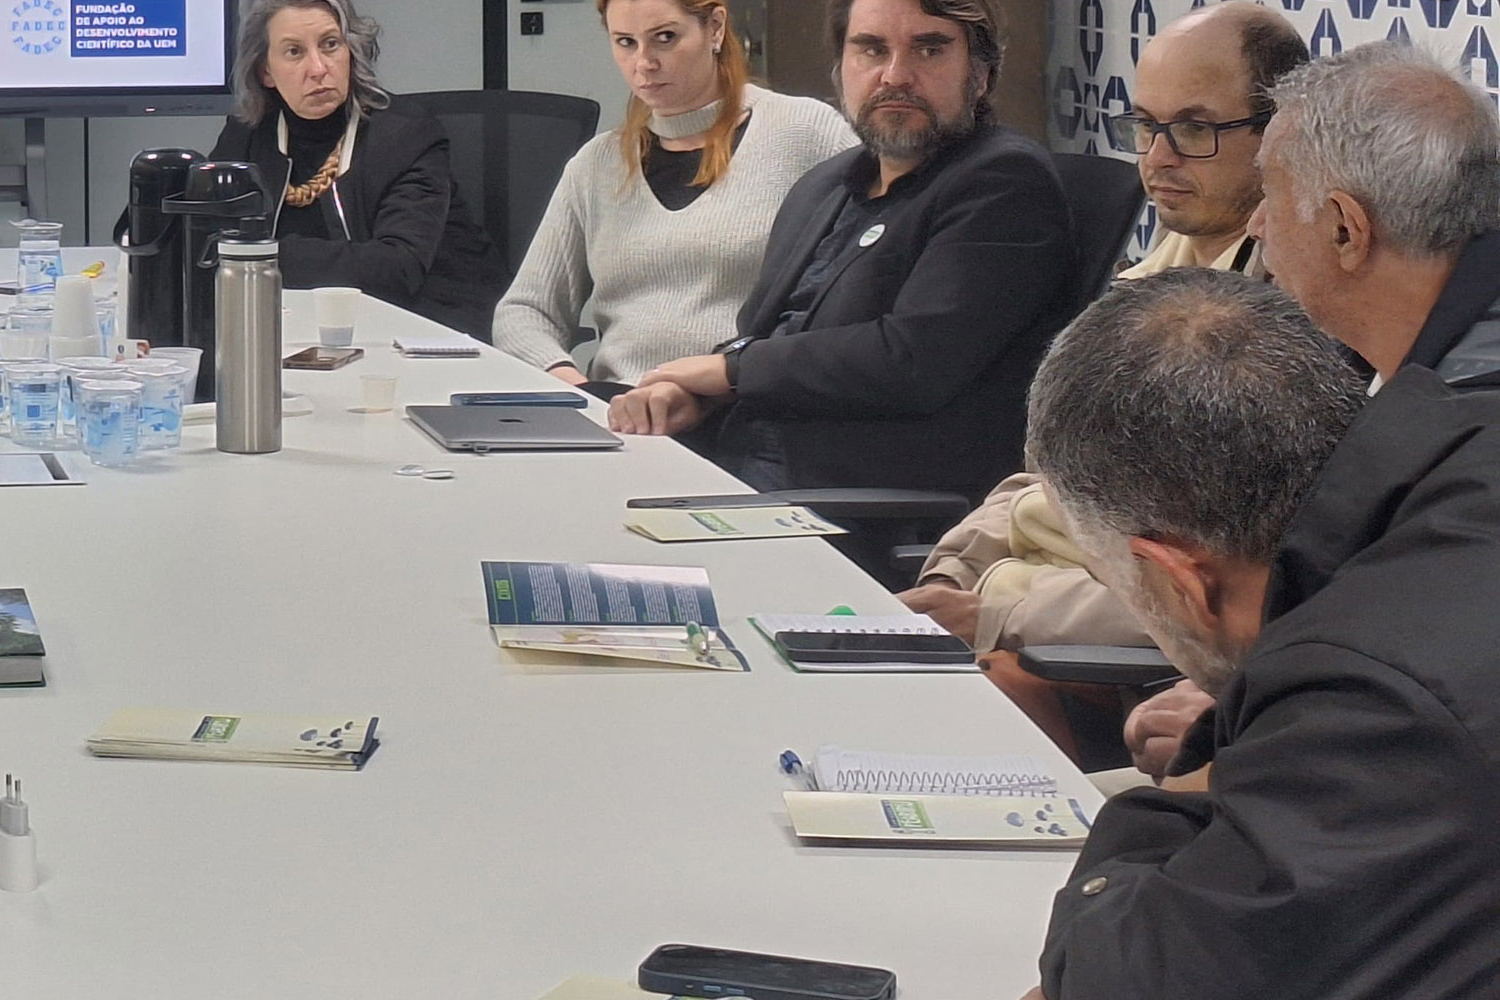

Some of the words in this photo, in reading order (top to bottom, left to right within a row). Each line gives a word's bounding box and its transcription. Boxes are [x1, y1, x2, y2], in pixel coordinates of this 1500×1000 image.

[76, 3, 135, 15] FUNDAÇÃO
[12, 21, 65, 31] FADEC
[76, 17, 90, 26] DE
[93, 17, 126, 26] APOIO
[128, 17, 145, 25] AO
[76, 28, 178, 37] DESENVOLVIMENTO
[76, 39, 135, 49] CIENTÍFICO
[137, 40, 152, 48] DA
[154, 40, 177, 48] UEM
